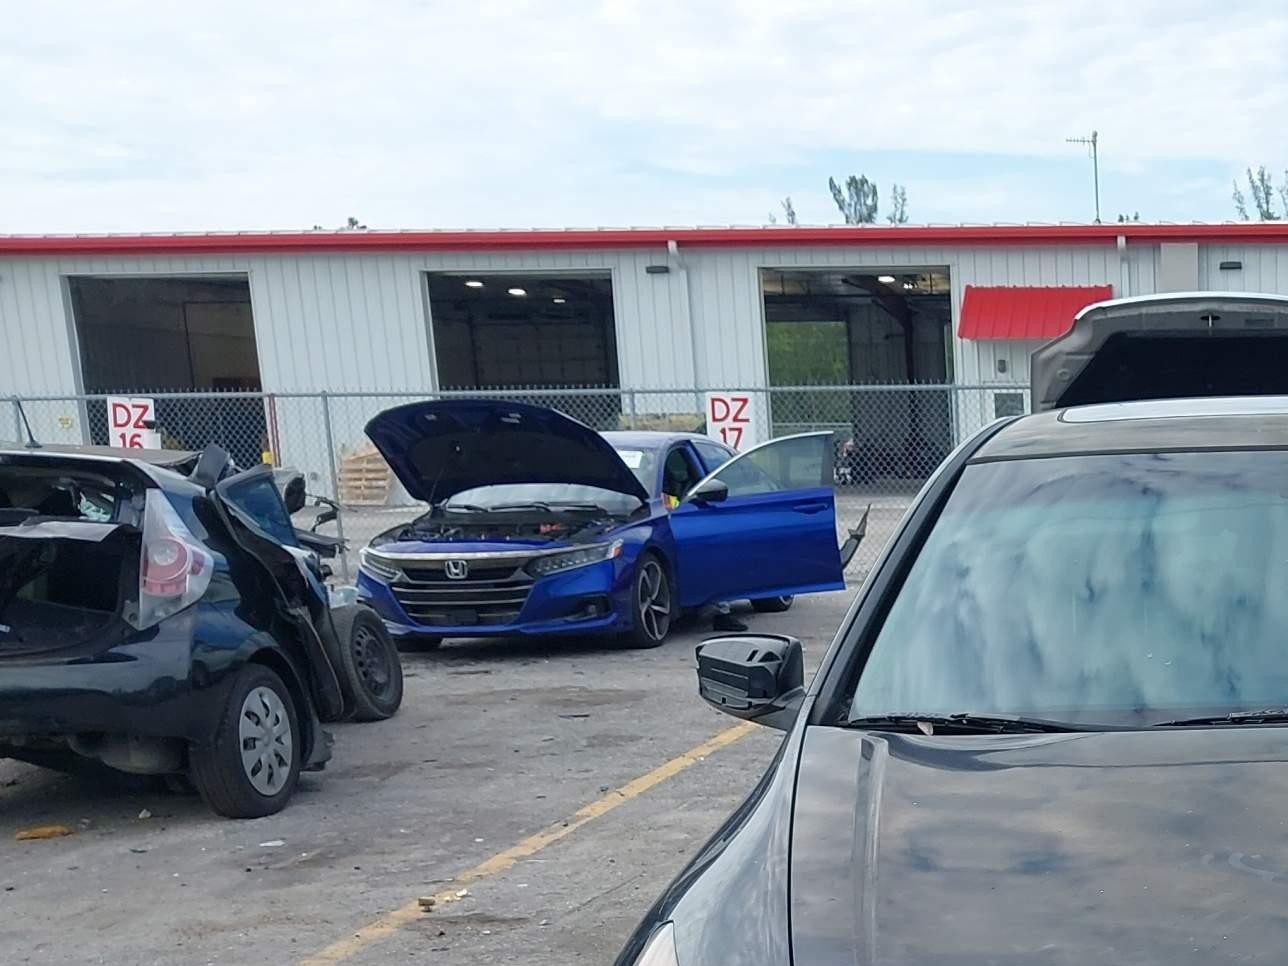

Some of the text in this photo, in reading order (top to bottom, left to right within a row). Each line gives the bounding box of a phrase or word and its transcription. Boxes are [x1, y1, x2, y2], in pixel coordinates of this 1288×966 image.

[111, 403, 149, 429] DZ
[711, 397, 750, 422] DZ
[719, 427, 743, 450] 17
